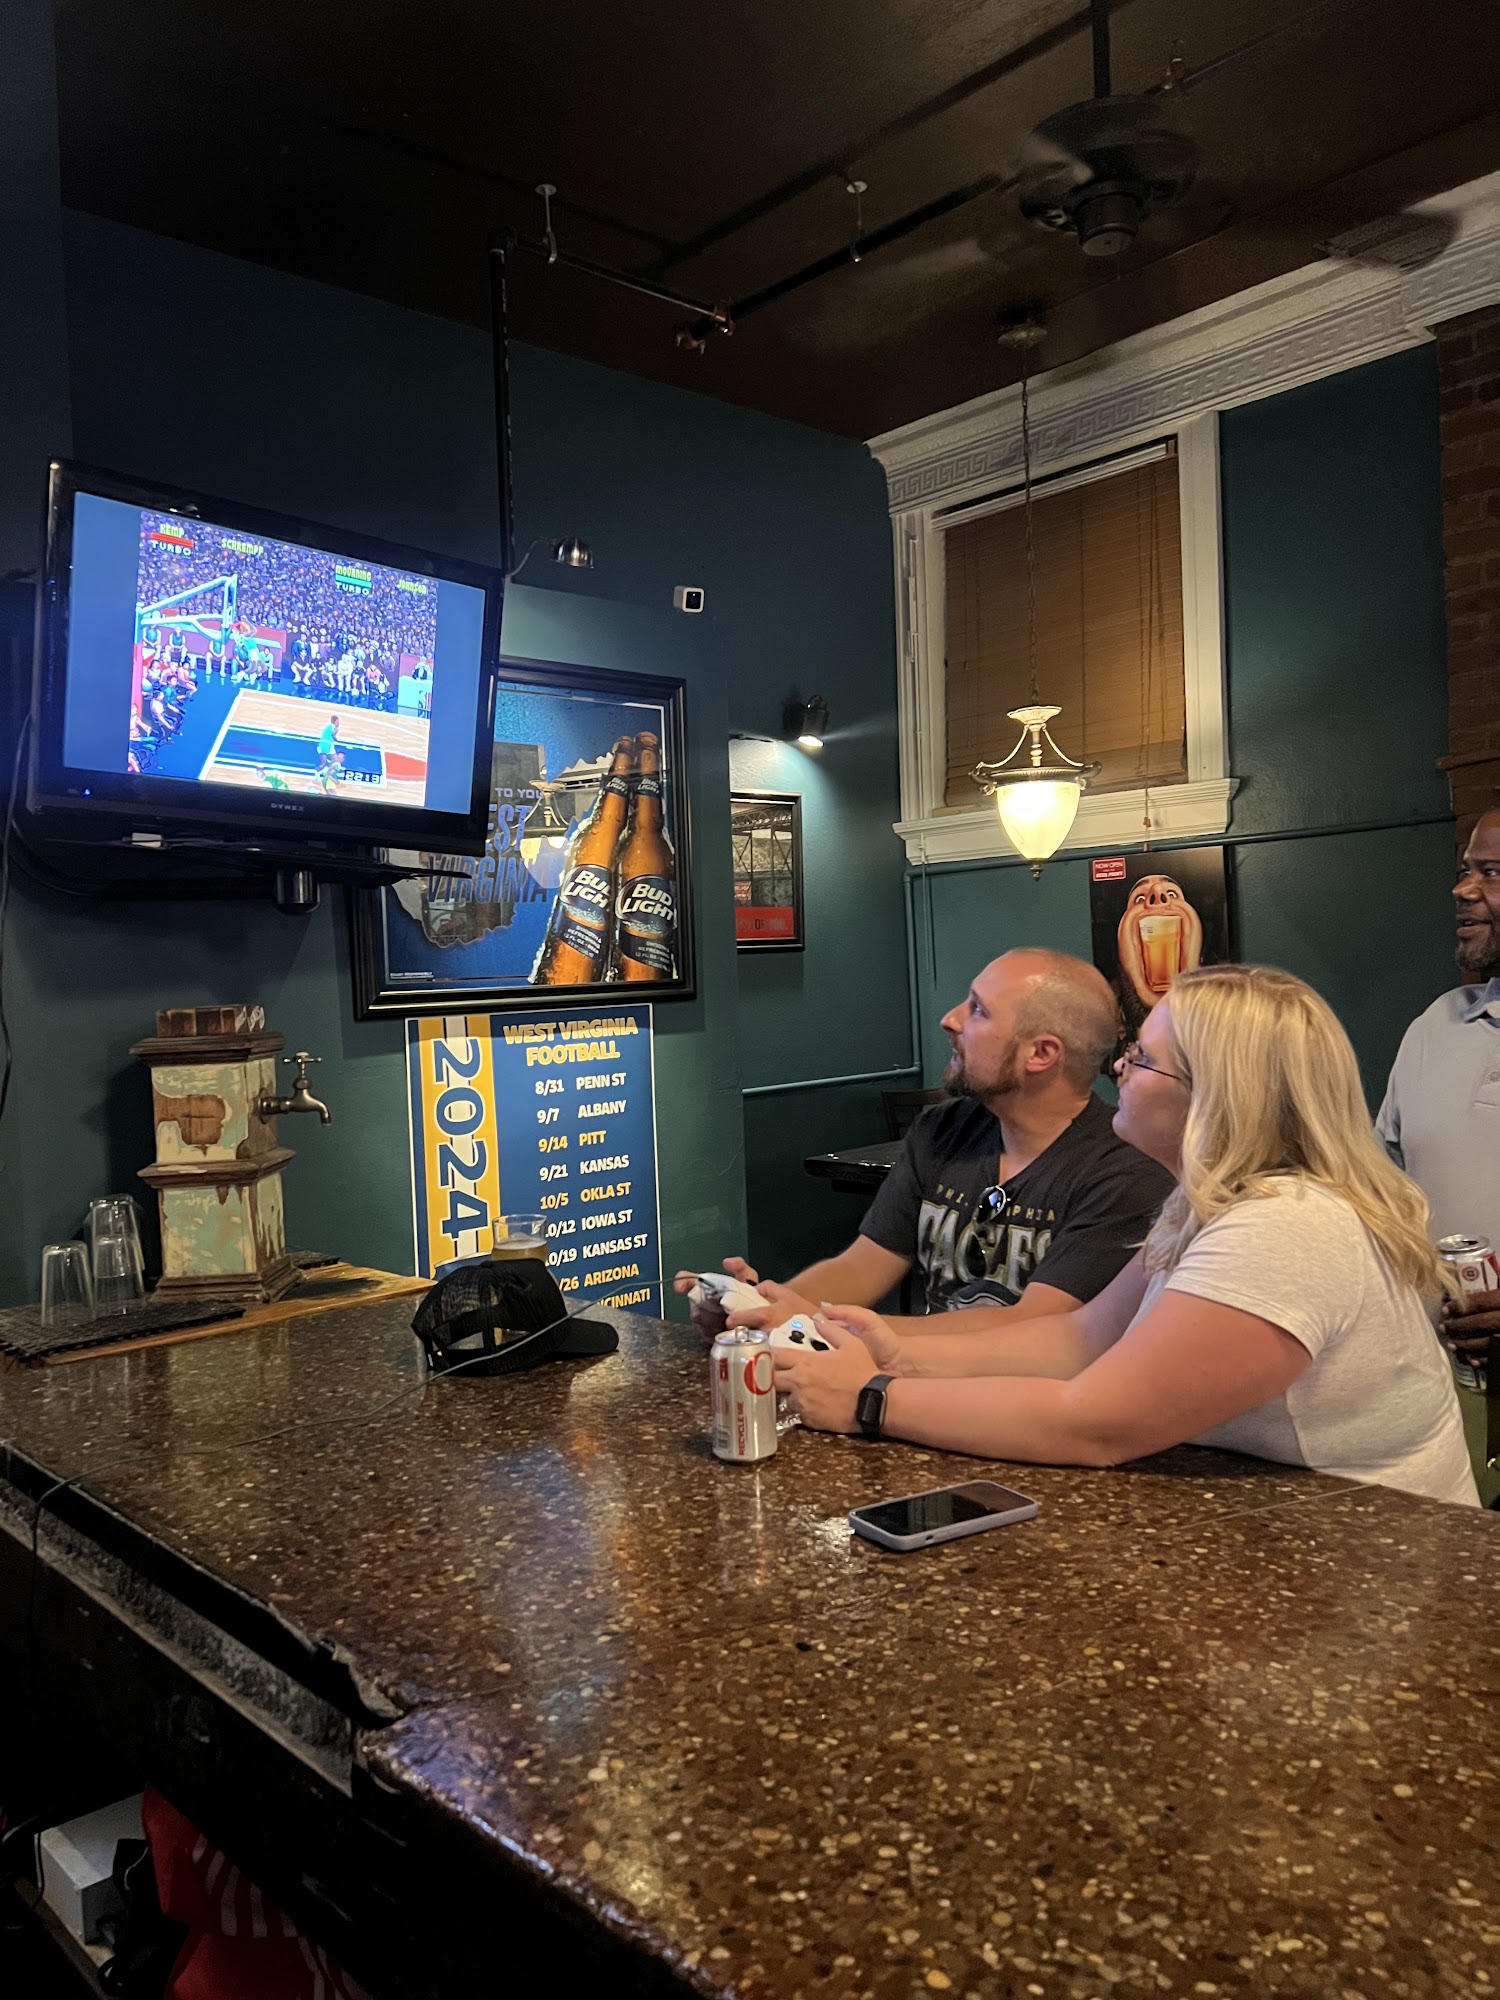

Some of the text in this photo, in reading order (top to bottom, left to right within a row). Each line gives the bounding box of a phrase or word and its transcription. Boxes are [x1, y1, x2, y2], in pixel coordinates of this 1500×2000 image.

[160, 523, 185, 538] KEMP
[151, 540, 192, 556] TURBO
[335, 564, 372, 582] MOURNING
[335, 582, 370, 596] TURBO
[494, 787, 514, 798] TO
[271, 802, 304, 812] DYNEX
[485, 803, 533, 852] EST
[563, 882, 609, 909] LIGH
[632, 883, 672, 907] BUD
[622, 898, 674, 921] LIGHT
[503, 1016, 639, 1045] WEST VIRGINIA
[526, 1040, 620, 1067] FOOTBALL
[535, 1072, 627, 1096] 8/31 PENN ST
[536, 1099, 627, 1125] 9/7 ALBANY
[432, 1037, 490, 1240] 2024
[538, 1130, 607, 1153] 9/14 PITT
[539, 1154, 630, 1182] 9/21 KANSAS
[540, 1181, 632, 1210] 10/5 OKLA ST
[545, 1208, 633, 1238] 0/12 IOWA ST
[545, 1233, 648, 1267] 0/19 KANSAS ST
[559, 1263, 640, 1292] /26 ARIZONA
[597, 1287, 651, 1309] CINNATI
